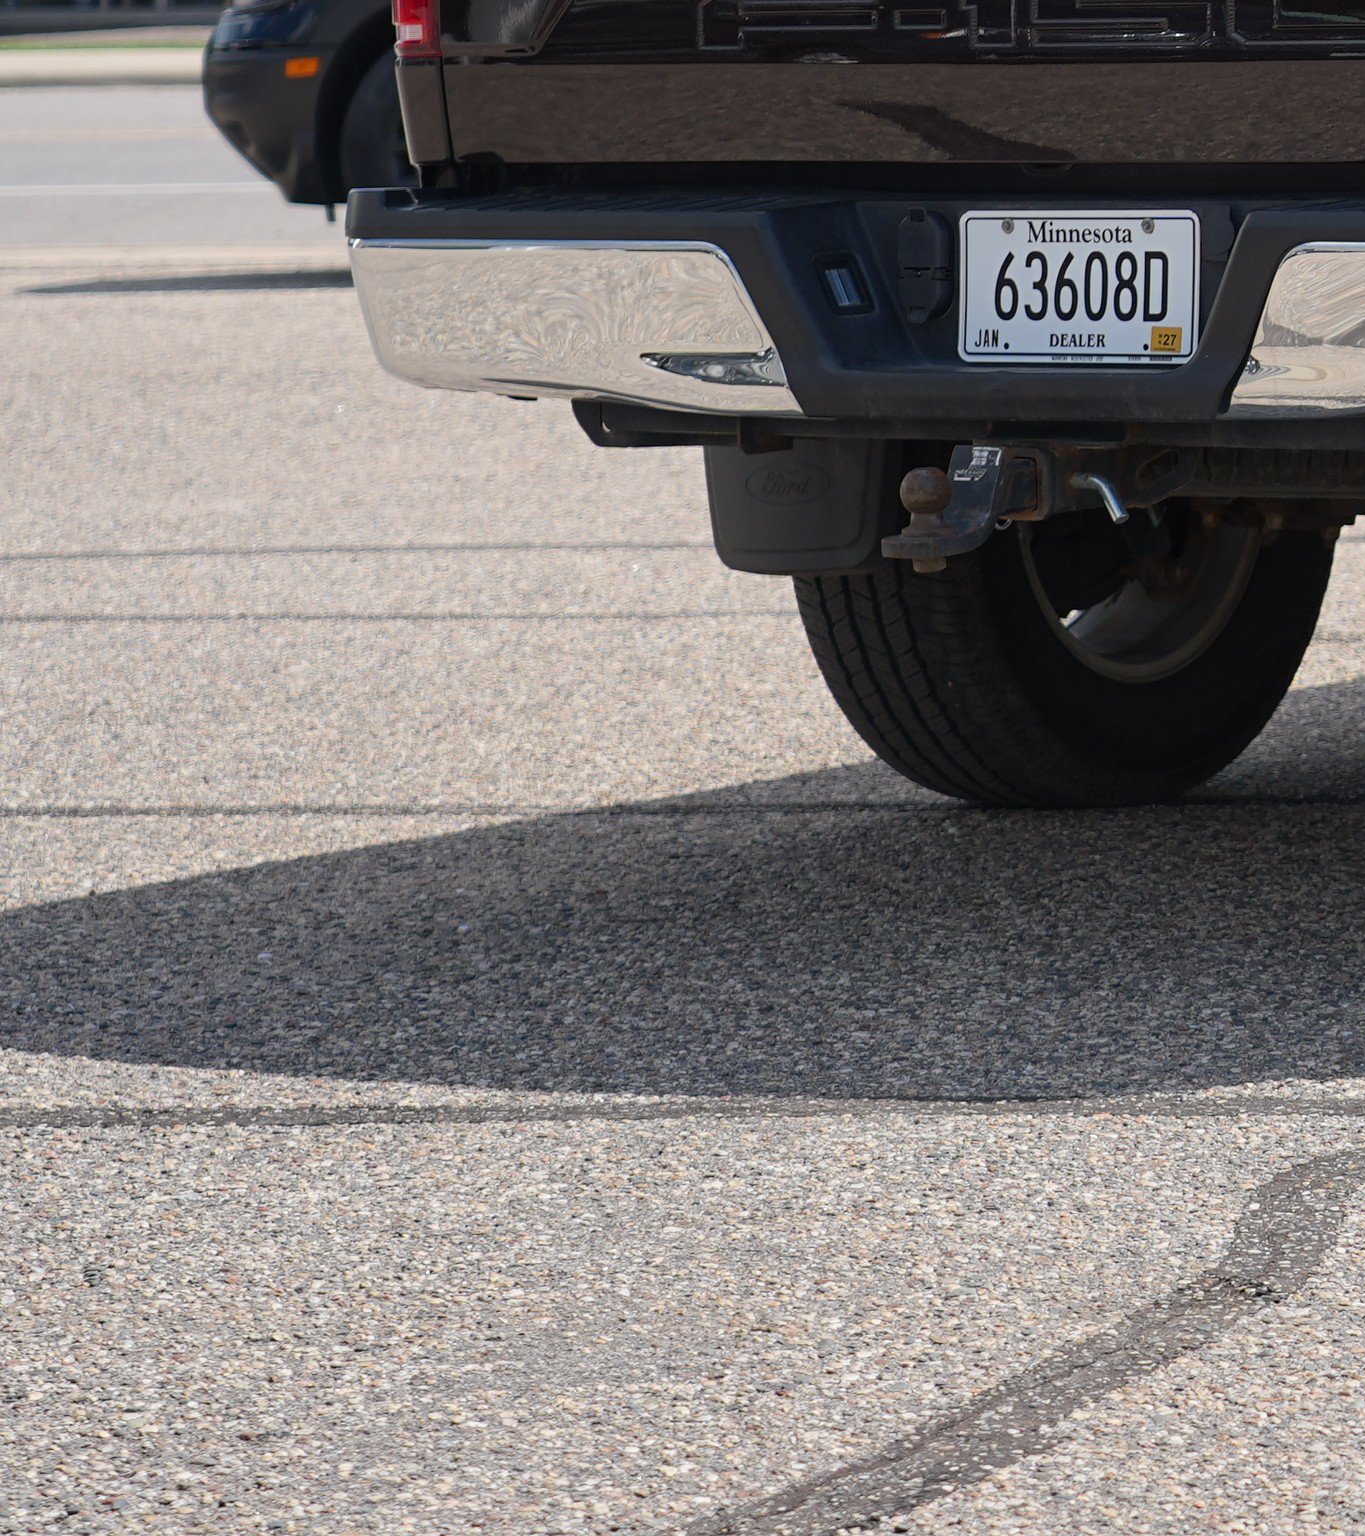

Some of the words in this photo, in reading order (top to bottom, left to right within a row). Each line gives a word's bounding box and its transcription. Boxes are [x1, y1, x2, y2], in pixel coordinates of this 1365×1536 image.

[1027, 220, 1133, 243] Minnesota
[994, 251, 1169, 322] 63608D
[974, 328, 999, 348] JAN
[1049, 333, 1106, 348] DEALER
[1162, 333, 1177, 346] 27
[762, 468, 812, 496] Ford
